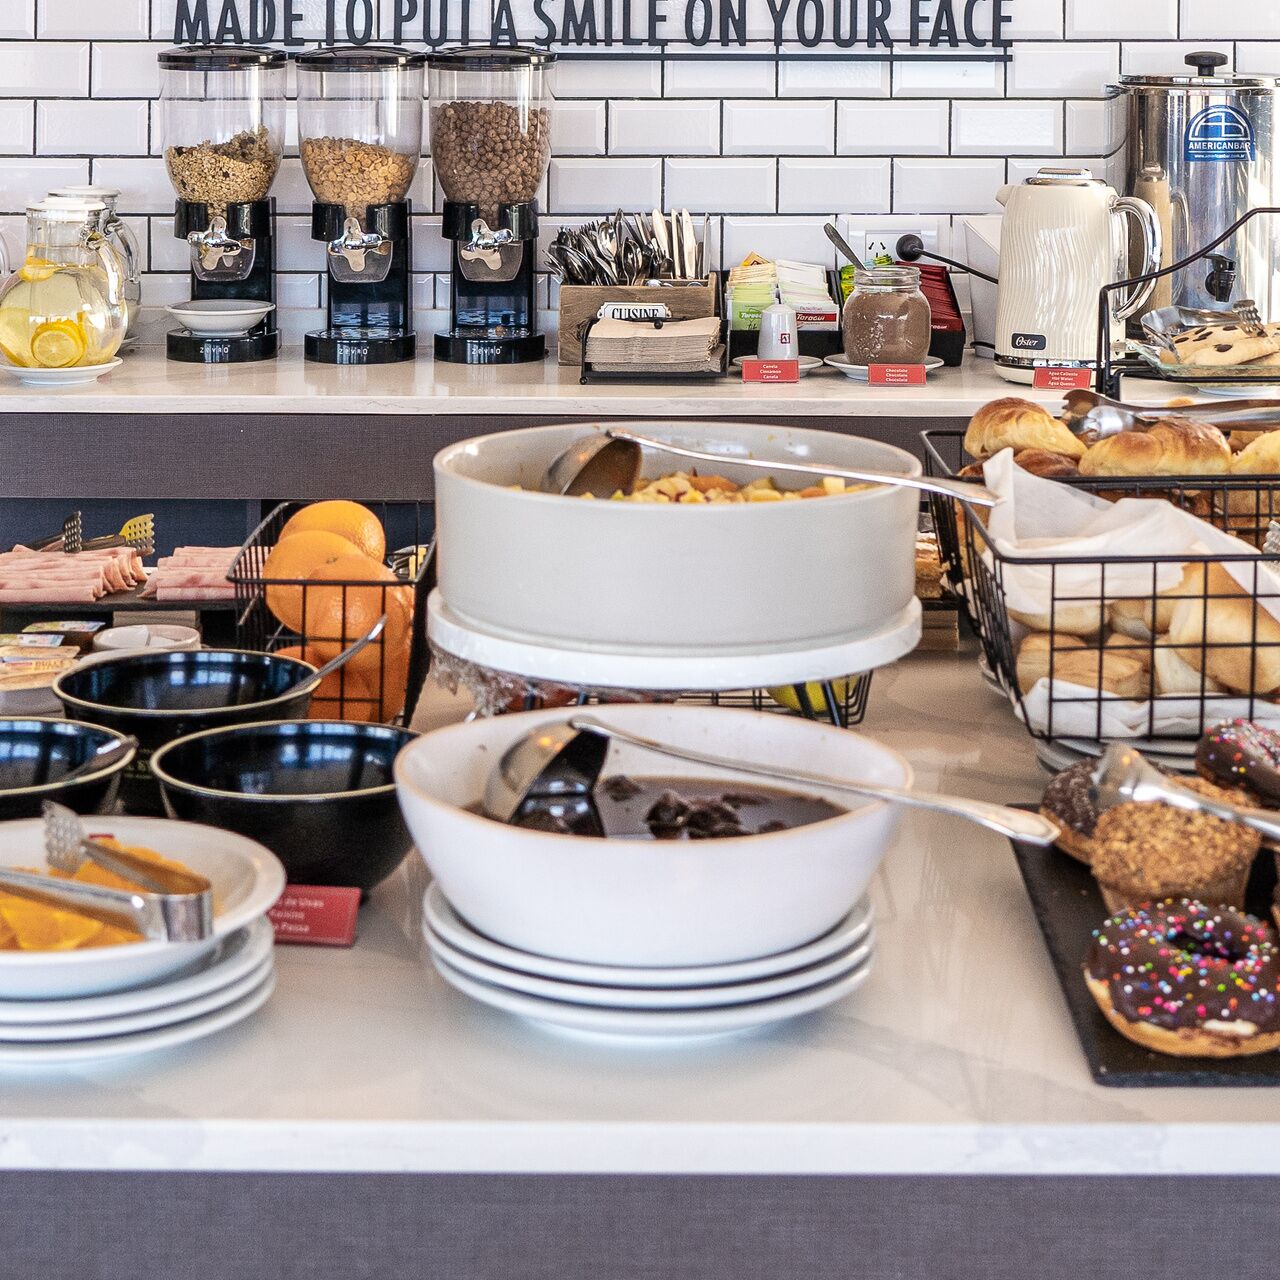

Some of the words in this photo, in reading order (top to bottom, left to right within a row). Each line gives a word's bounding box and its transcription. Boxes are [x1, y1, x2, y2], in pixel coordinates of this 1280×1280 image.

[1188, 141, 1250, 150] AMERICANBAR
[611, 307, 659, 319] CUISINE
[1015, 336, 1039, 347] Oster
